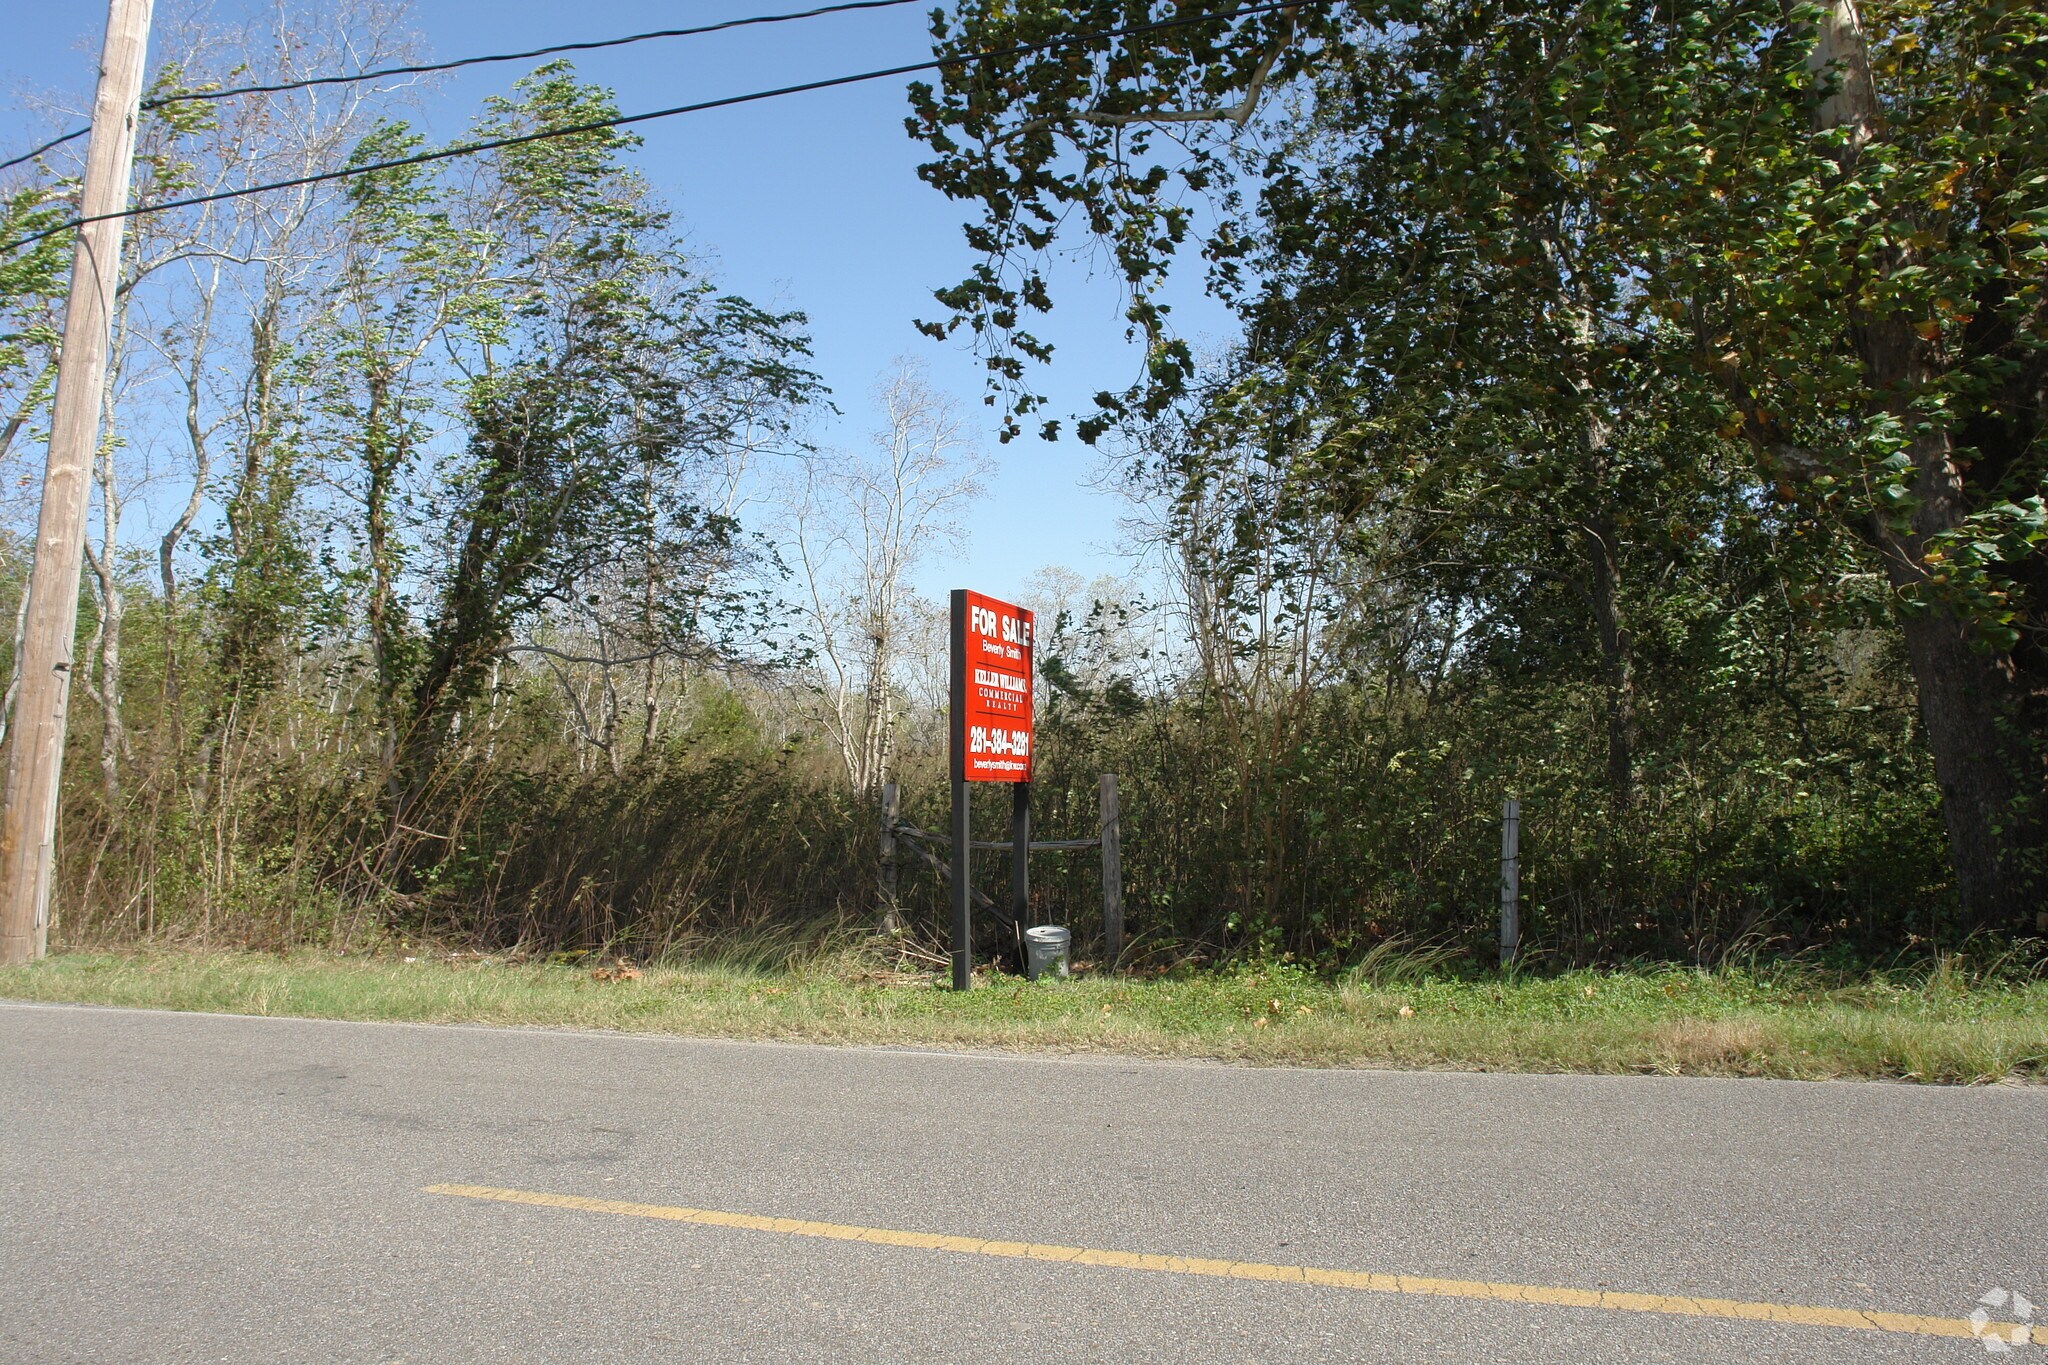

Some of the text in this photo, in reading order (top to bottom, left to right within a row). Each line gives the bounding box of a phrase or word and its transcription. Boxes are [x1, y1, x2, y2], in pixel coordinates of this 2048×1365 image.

[971, 605, 1030, 647] FOR SALE
[982, 639, 1022, 660] Beverly Smith
[975, 668, 1027, 693] KELLER WILLIAMS
[978, 687, 1023, 704] COMMERCIAL
[986, 699, 1017, 712] REALTY
[970, 725, 1029, 757] 281-384-3281
[974, 758, 1027, 771] beverlysmith@kw.com
